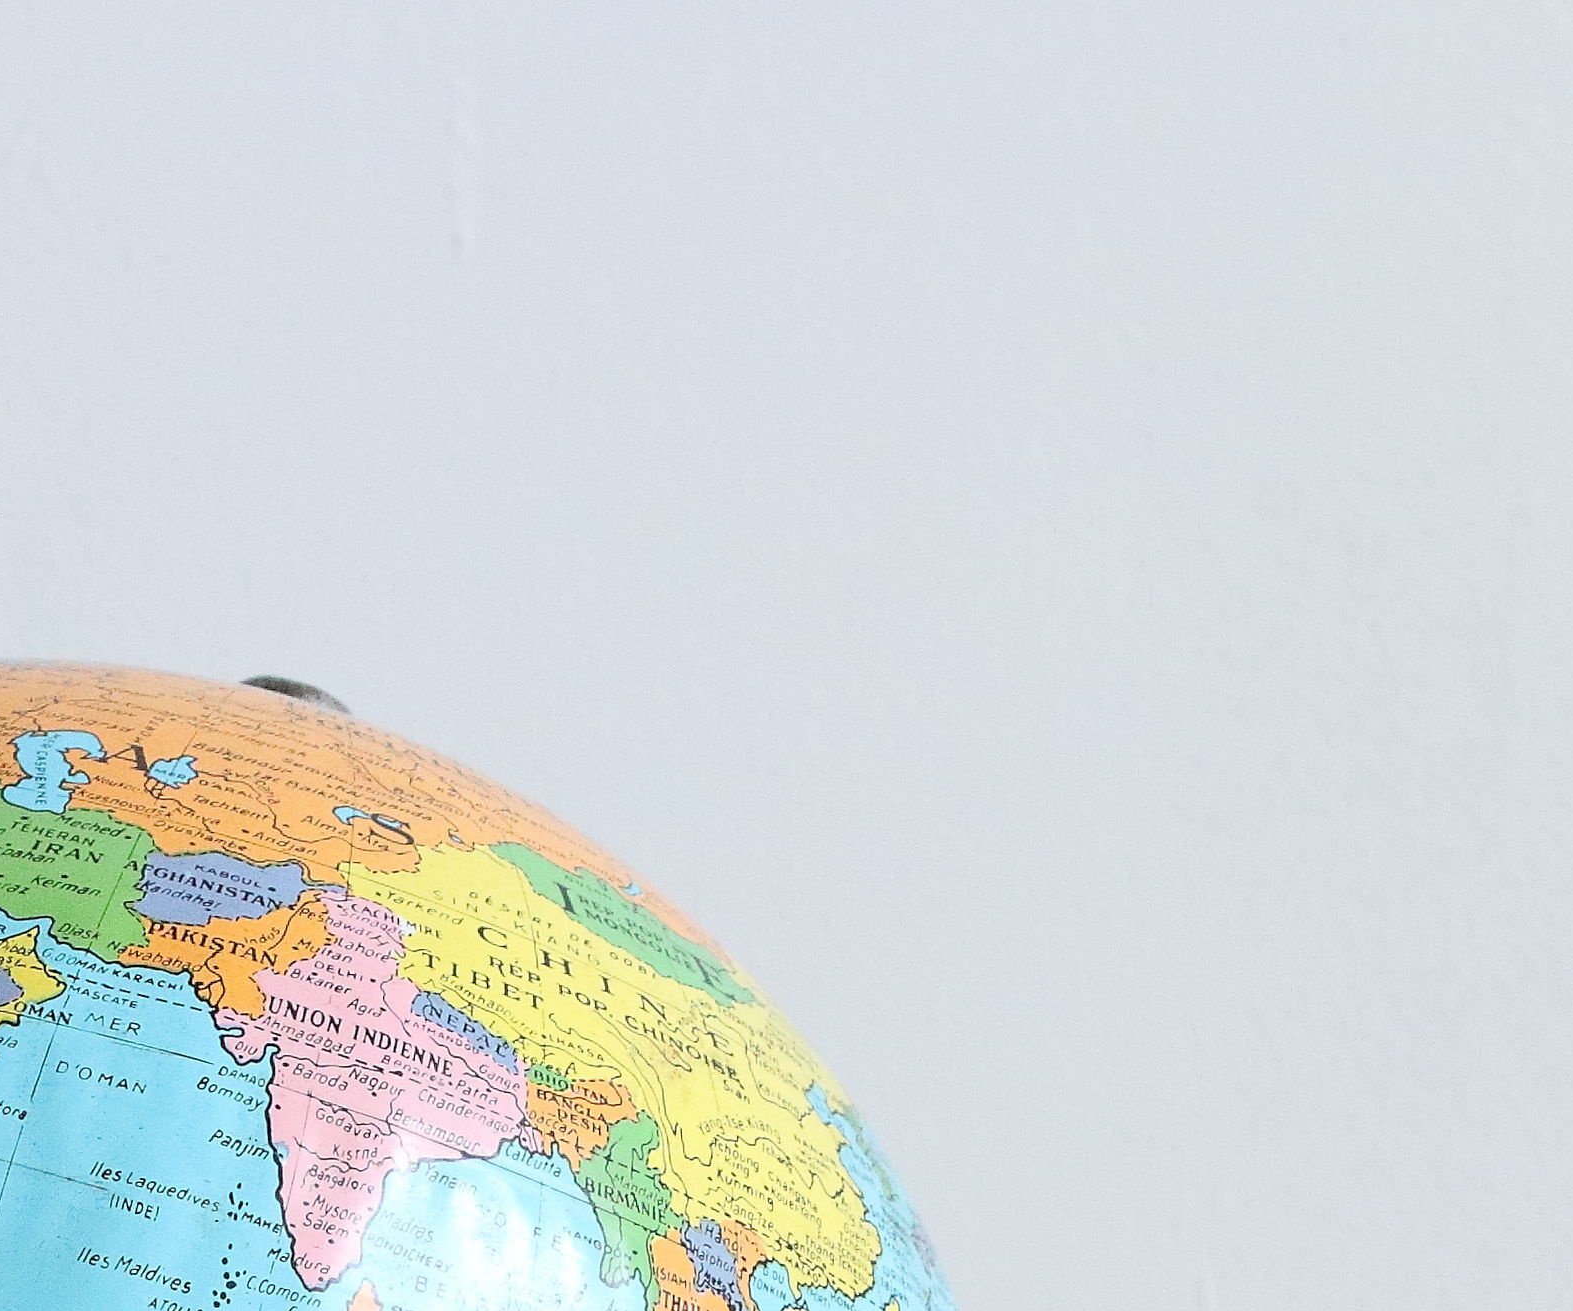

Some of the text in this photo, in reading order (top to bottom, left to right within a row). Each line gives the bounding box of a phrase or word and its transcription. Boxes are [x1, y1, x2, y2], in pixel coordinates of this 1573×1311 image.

[10, 818, 96, 847] TEHERAN
[32, 840, 105, 864] IRAN
[31, 874, 101, 898] Kerman
[127, 859, 283, 909] AFGHANISTAN
[195, 864, 260, 887] KABOUL
[141, 879, 221, 909] Kandahar
[387, 892, 463, 925] Yarkend
[149, 924, 277, 966] PAKISTAN
[113, 970, 184, 990] KARACHI
[290, 968, 352, 994] Bikaner
[315, 962, 363, 981] DELHI
[422, 953, 543, 1009] TIBET
[69, 985, 137, 1009] MASCATE
[13, 1002, 73, 1024] OMAN
[85, 1014, 141, 1035] MER
[235, 1041, 257, 1055] DIU
[269, 996, 453, 1078] UNION INDIENNE
[292, 1064, 348, 1091] Baroda
[349, 1068, 405, 1097] Nagpur
[197, 1081, 264, 1111] Bombay
[209, 1130, 270, 1160] Panjim
[127, 1173, 219, 1212] Laquedives
[585, 1177, 668, 1224] BIRMANIE
[314, 1195, 362, 1224] Mysore
[303, 1212, 349, 1239] Salem
[115, 1258, 191, 1293] Maldives
